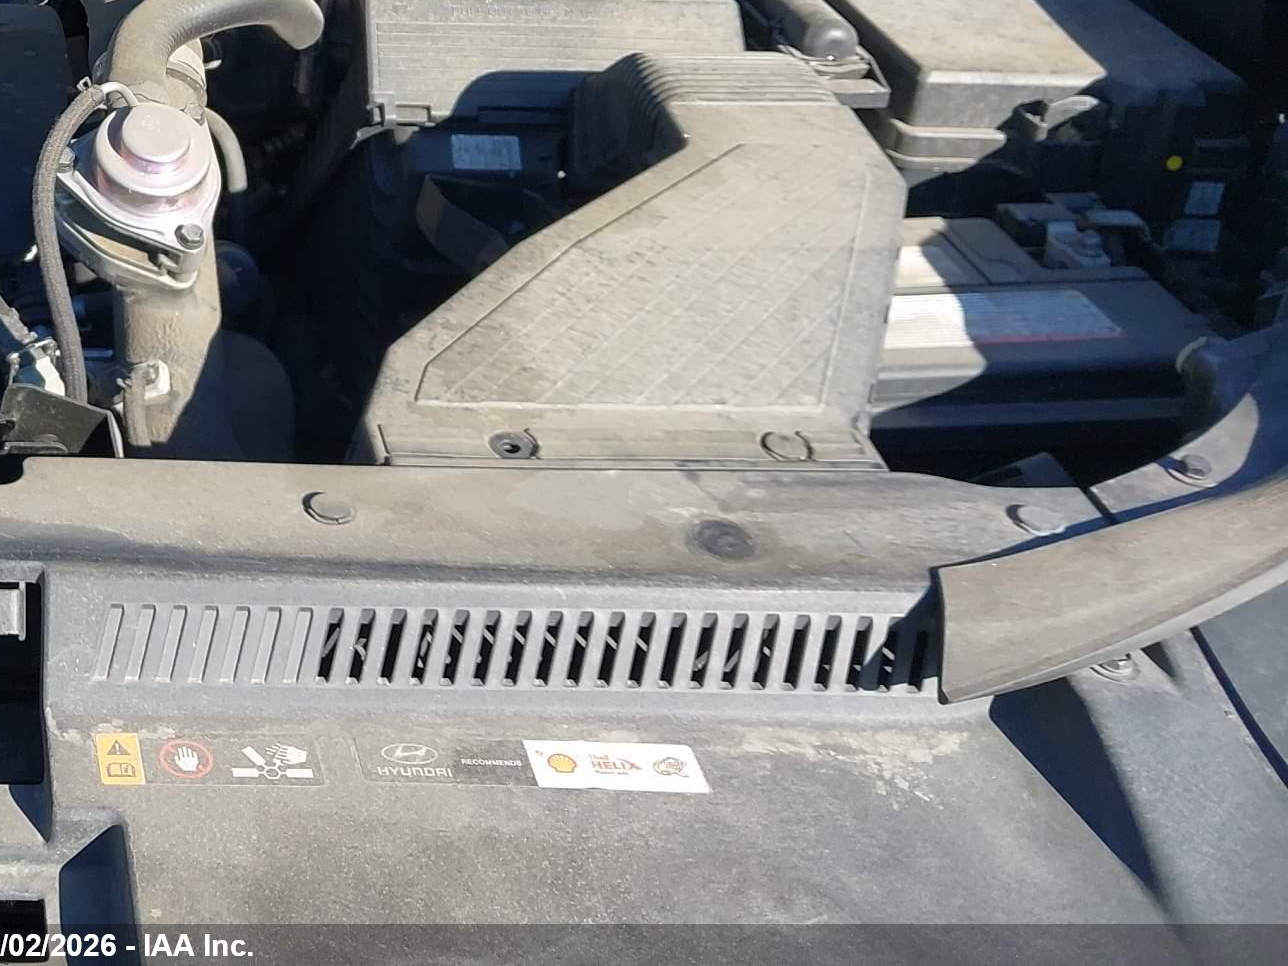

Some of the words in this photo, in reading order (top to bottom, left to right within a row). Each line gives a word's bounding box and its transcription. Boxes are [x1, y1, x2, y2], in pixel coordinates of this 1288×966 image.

[460, 758, 523, 768] RECOMMENDS
[590, 758, 643, 772] HELIX
[376, 766, 454, 779] HYUNDAI
